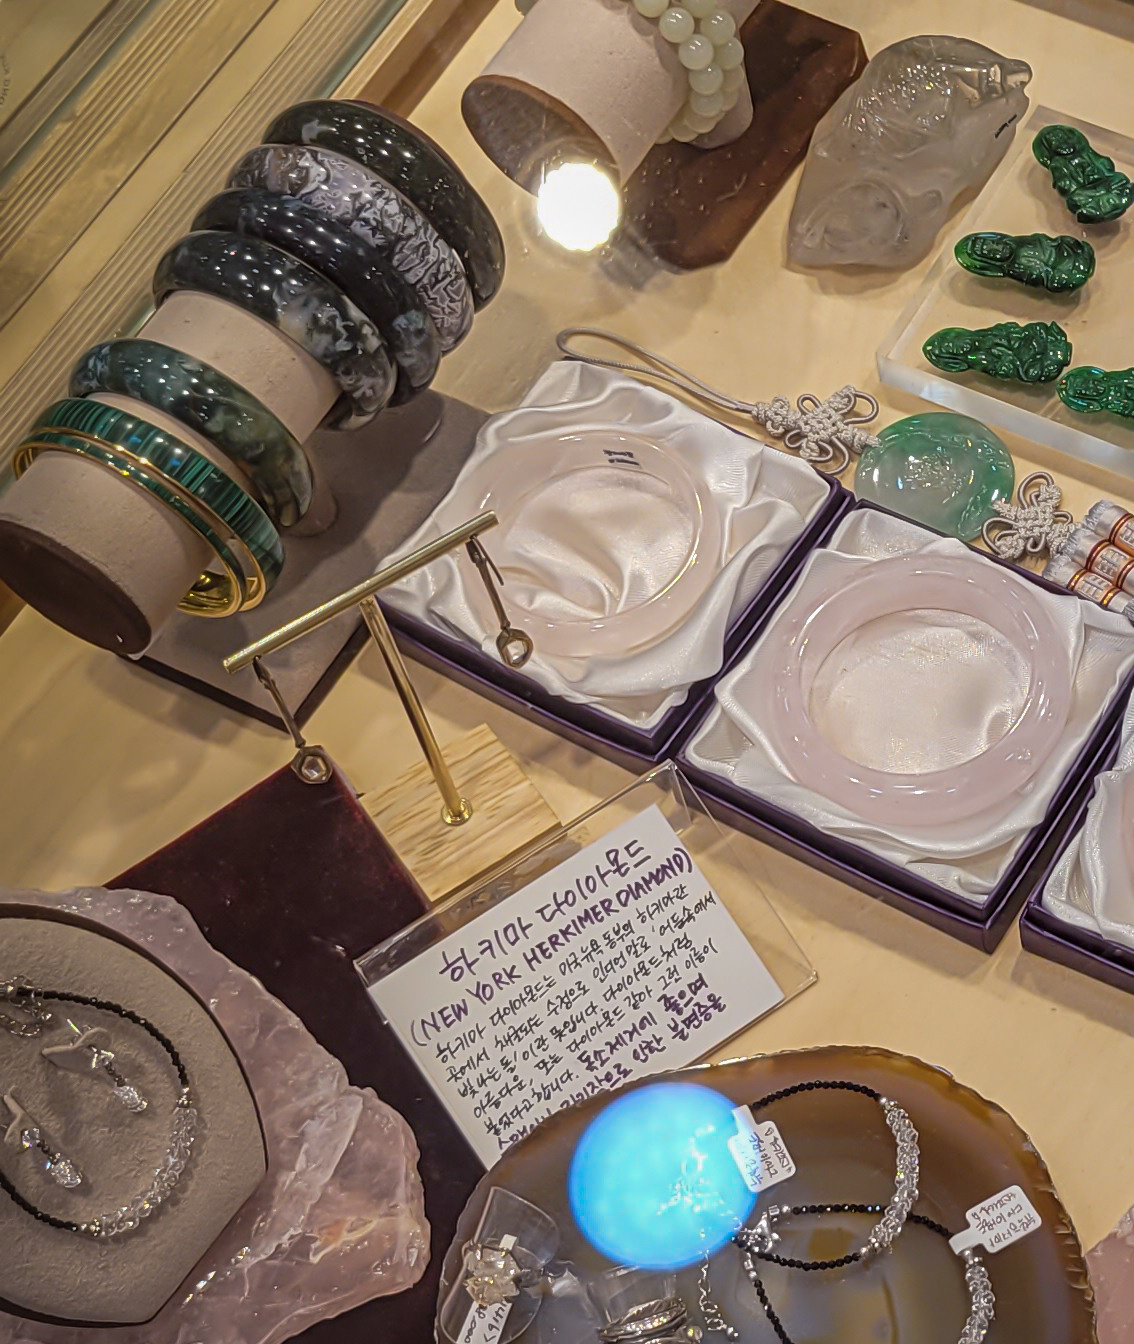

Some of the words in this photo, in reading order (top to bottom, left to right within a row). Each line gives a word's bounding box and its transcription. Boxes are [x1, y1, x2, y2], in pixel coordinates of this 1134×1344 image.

[410, 998, 469, 1047] (NEW
[464, 964, 523, 1006] YORK
[522, 897, 620, 972] HERKIMER
[615, 840, 693, 908] DIAMOND)
[435, 1022, 487, 1064] 하키마
[488, 975, 557, 1027] 다이아몬드는
[635, 883, 689, 924] 하키마란
[438, 916, 534, 983] 하키마
[534, 839, 652, 923] 다이아몬드
[445, 1046, 491, 1083] 곳에서
[546, 980, 591, 1017] 수정으로
[625, 935, 652, 959] 말로
[533, 1053, 564, 1077] 또는
[559, 1005, 626, 1053] 다이아몬드
[622, 984, 653, 1011] 같아
[656, 964, 683, 991] 그런
[684, 937, 719, 970] 이름이
[666, 992, 727, 1042] 불면증을
